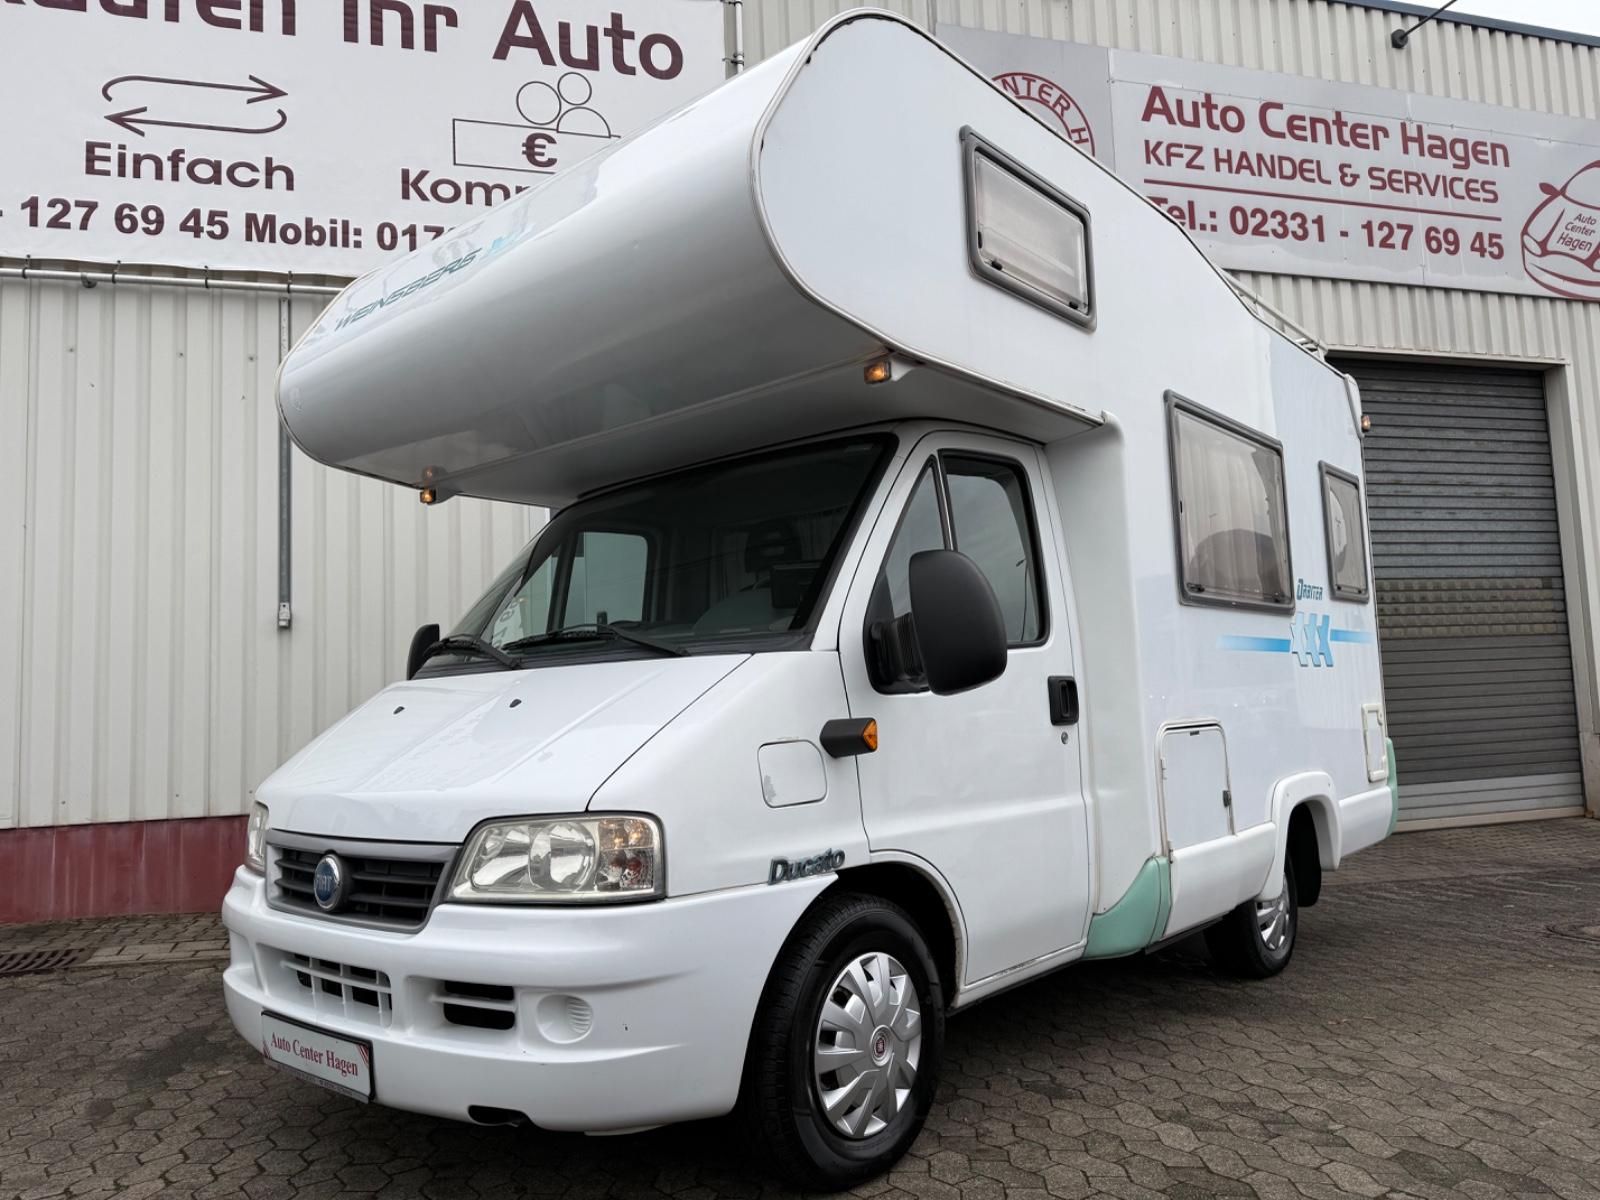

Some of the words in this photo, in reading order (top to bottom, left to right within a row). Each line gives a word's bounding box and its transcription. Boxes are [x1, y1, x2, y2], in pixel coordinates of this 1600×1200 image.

[492, 0, 684, 80] Auto
[1141, 85, 1245, 133] Auto
[1259, 102, 1389, 150] Center
[1400, 121, 1510, 170] Hagen
[85, 141, 295, 191] Einfach
[401, 168, 531, 206] Kom
[1144, 139, 1205, 170] KFZ
[1214, 148, 1331, 185] HANDEL
[1339, 163, 1360, 187] &
[1368, 166, 1499, 204] SERVICES
[21, 196, 98, 231] 127
[114, 203, 165, 236] 69
[179, 208, 230, 240] 45
[245, 212, 362, 249] Mobil:
[376, 221, 456, 252] 017
[1229, 205, 1325, 242] 02331
[1361, 219, 1414, 250] 127
[1424, 225, 1460, 256] 69
[1470, 231, 1505, 260] 45
[1557, 232, 1592, 251] Hagen
[1565, 221, 1596, 236] Center
[1574, 213, 1597, 225] Auto
[768, 848, 846, 885] Ducato
[271, 1032, 291, 1053] Auto
[292, 1039, 323, 1064] Center
[326, 1049, 358, 1077] Hagen
